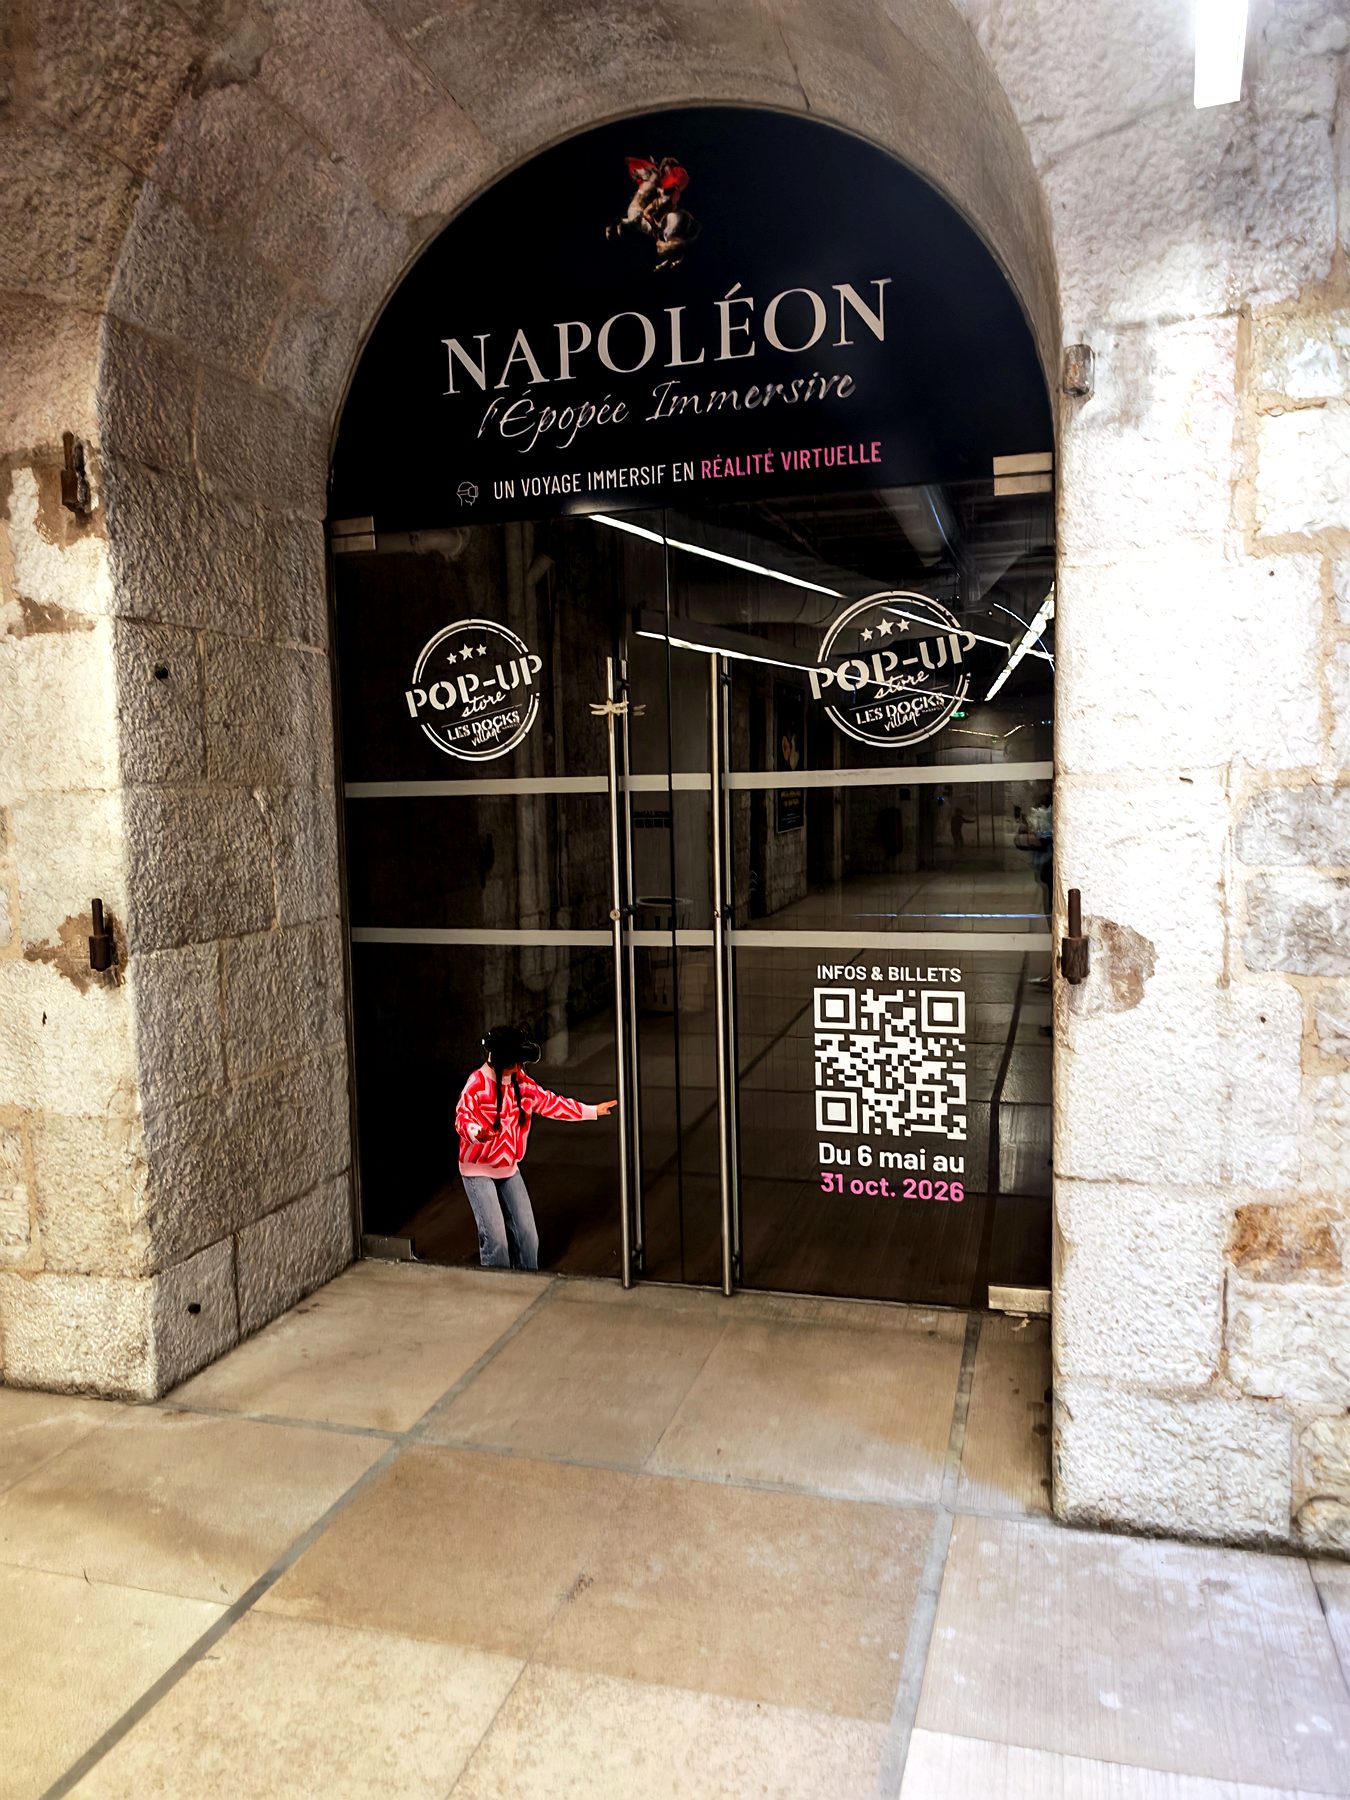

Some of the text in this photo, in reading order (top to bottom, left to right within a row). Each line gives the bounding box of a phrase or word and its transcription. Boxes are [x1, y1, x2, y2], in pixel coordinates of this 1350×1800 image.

[441, 277, 892, 396] NAPOLÉON
[477, 371, 857, 454] l'Épopée Immersive
[493, 442, 882, 499] UN VOYAGE IMMERSIF EN RÉALITÉ VIRTUELLE
[808, 631, 976, 700] POP-UP
[405, 654, 542, 717] POP-UP
[874, 670, 929, 699] store
[461, 691, 506, 717] store
[856, 692, 945, 725] LES DOCKS
[447, 710, 520, 741] LES DOCKS
[817, 965, 962, 983] INFOS & BILLETS
[819, 1142, 965, 1173] Du 6 mai au
[820, 1172, 965, 1202] 31 oct. 2026
